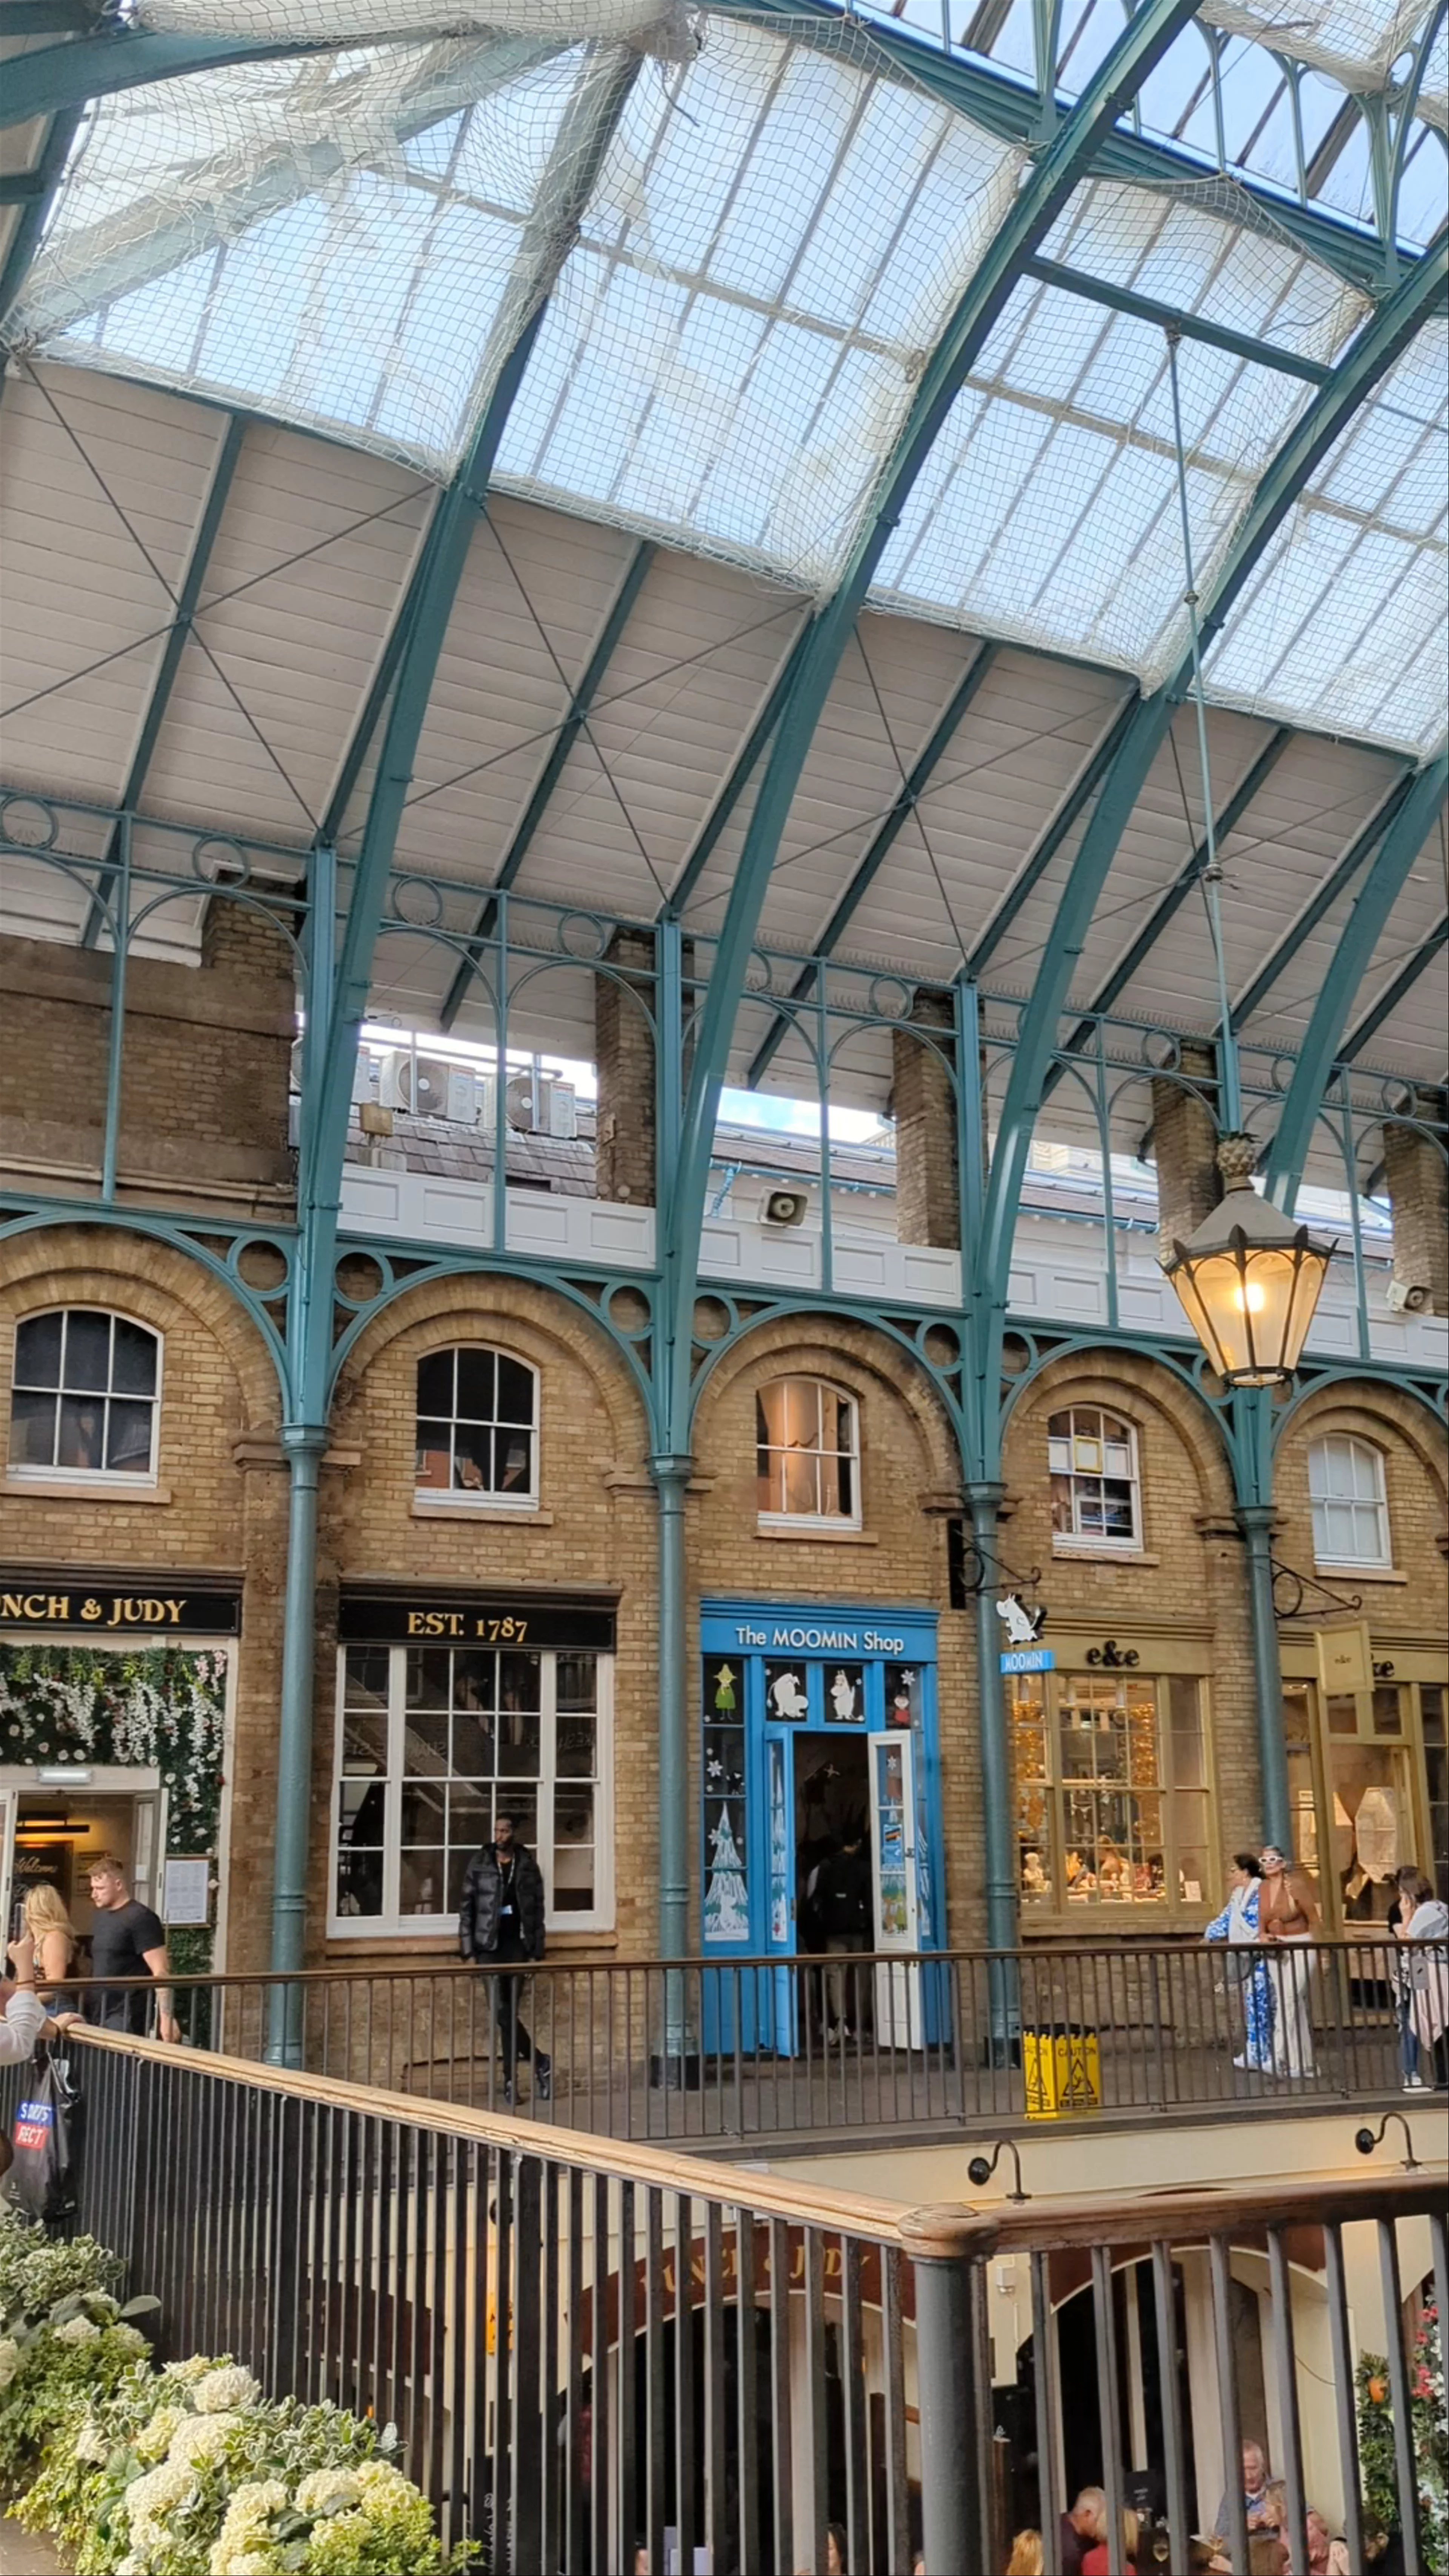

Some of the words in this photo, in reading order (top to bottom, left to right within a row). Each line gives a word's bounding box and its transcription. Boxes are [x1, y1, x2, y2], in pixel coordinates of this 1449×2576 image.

[0, 1594, 69, 1619] NCH
[80, 1598, 102, 1620] &
[106, 1598, 187, 1626] JUDY
[407, 1612, 465, 1636] EST.
[476, 1616, 528, 1642] 1787
[736, 1625, 767, 1645] The
[772, 1627, 857, 1649] MOOMIN
[863, 1631, 904, 1655] Shop
[1086, 1640, 1140, 1668] e&e
